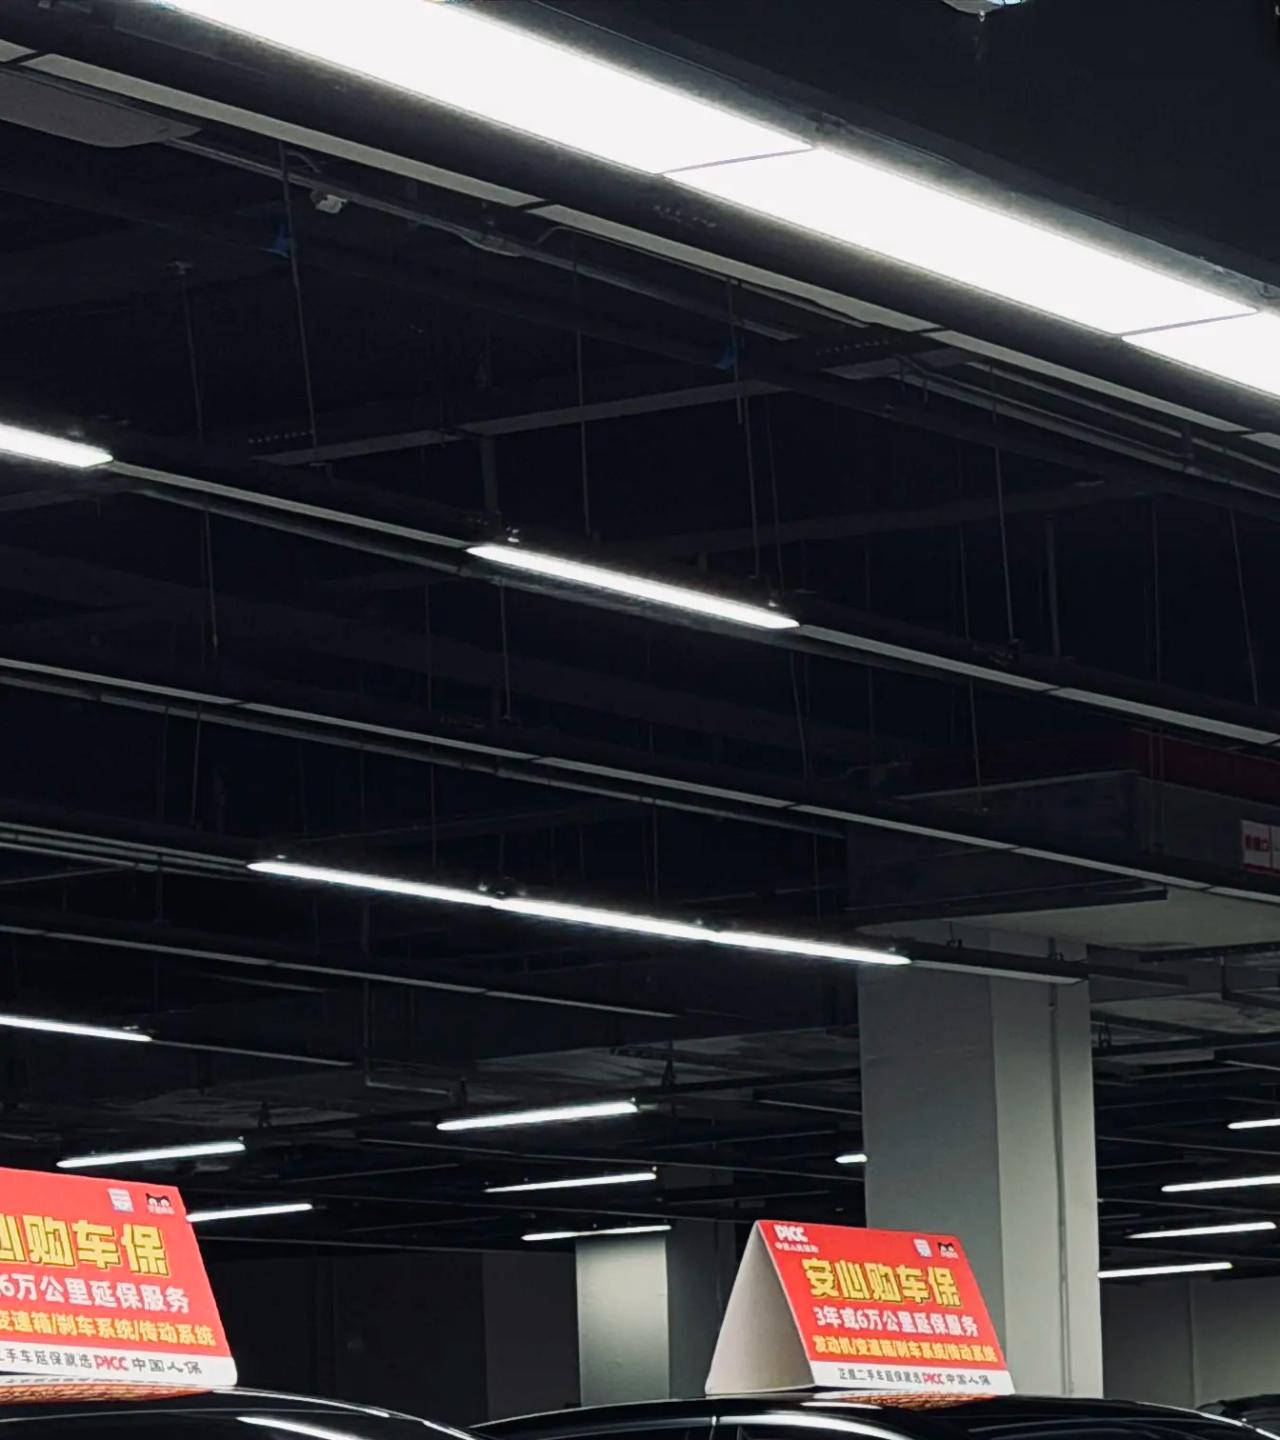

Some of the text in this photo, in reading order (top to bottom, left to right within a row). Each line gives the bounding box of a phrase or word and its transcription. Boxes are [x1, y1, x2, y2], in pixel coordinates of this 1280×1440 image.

[801, 1257, 962, 1308] 安心购车保
[812, 1305, 979, 1337] 3年或6万公里延保服务
